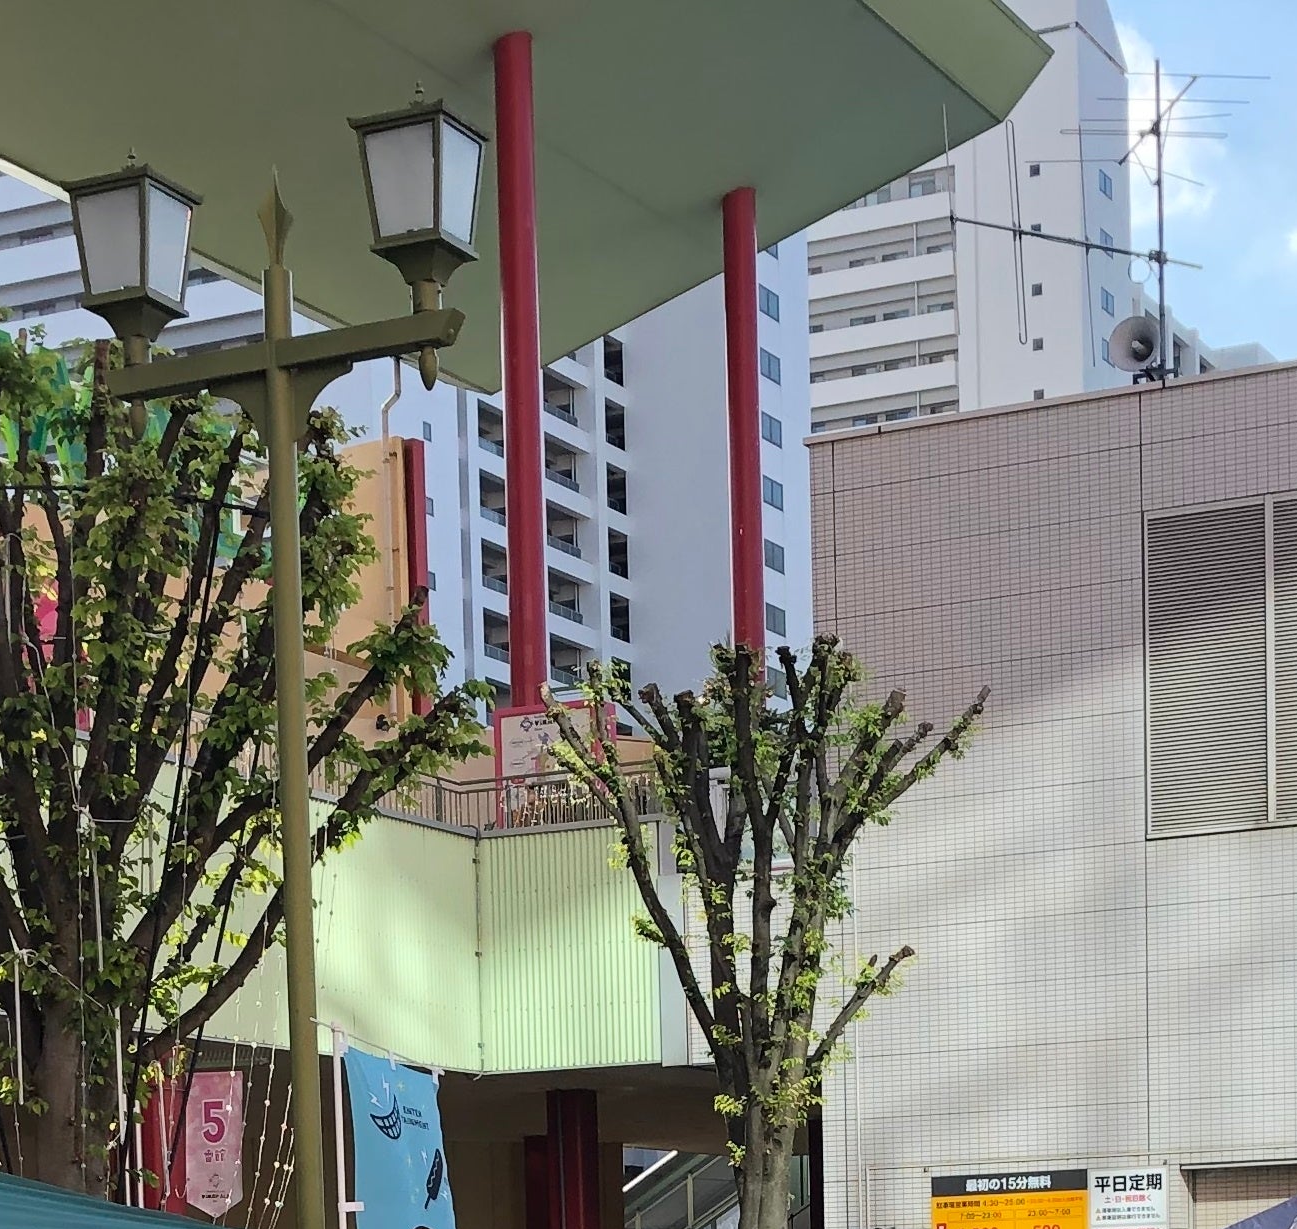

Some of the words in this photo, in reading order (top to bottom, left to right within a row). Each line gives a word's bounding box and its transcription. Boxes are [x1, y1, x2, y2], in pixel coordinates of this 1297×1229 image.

[202, 1100, 226, 1144] 5
[965, 1175, 1052, 1193] 最初の15分無料
[1094, 1173, 1163, 1194] 平日定期
